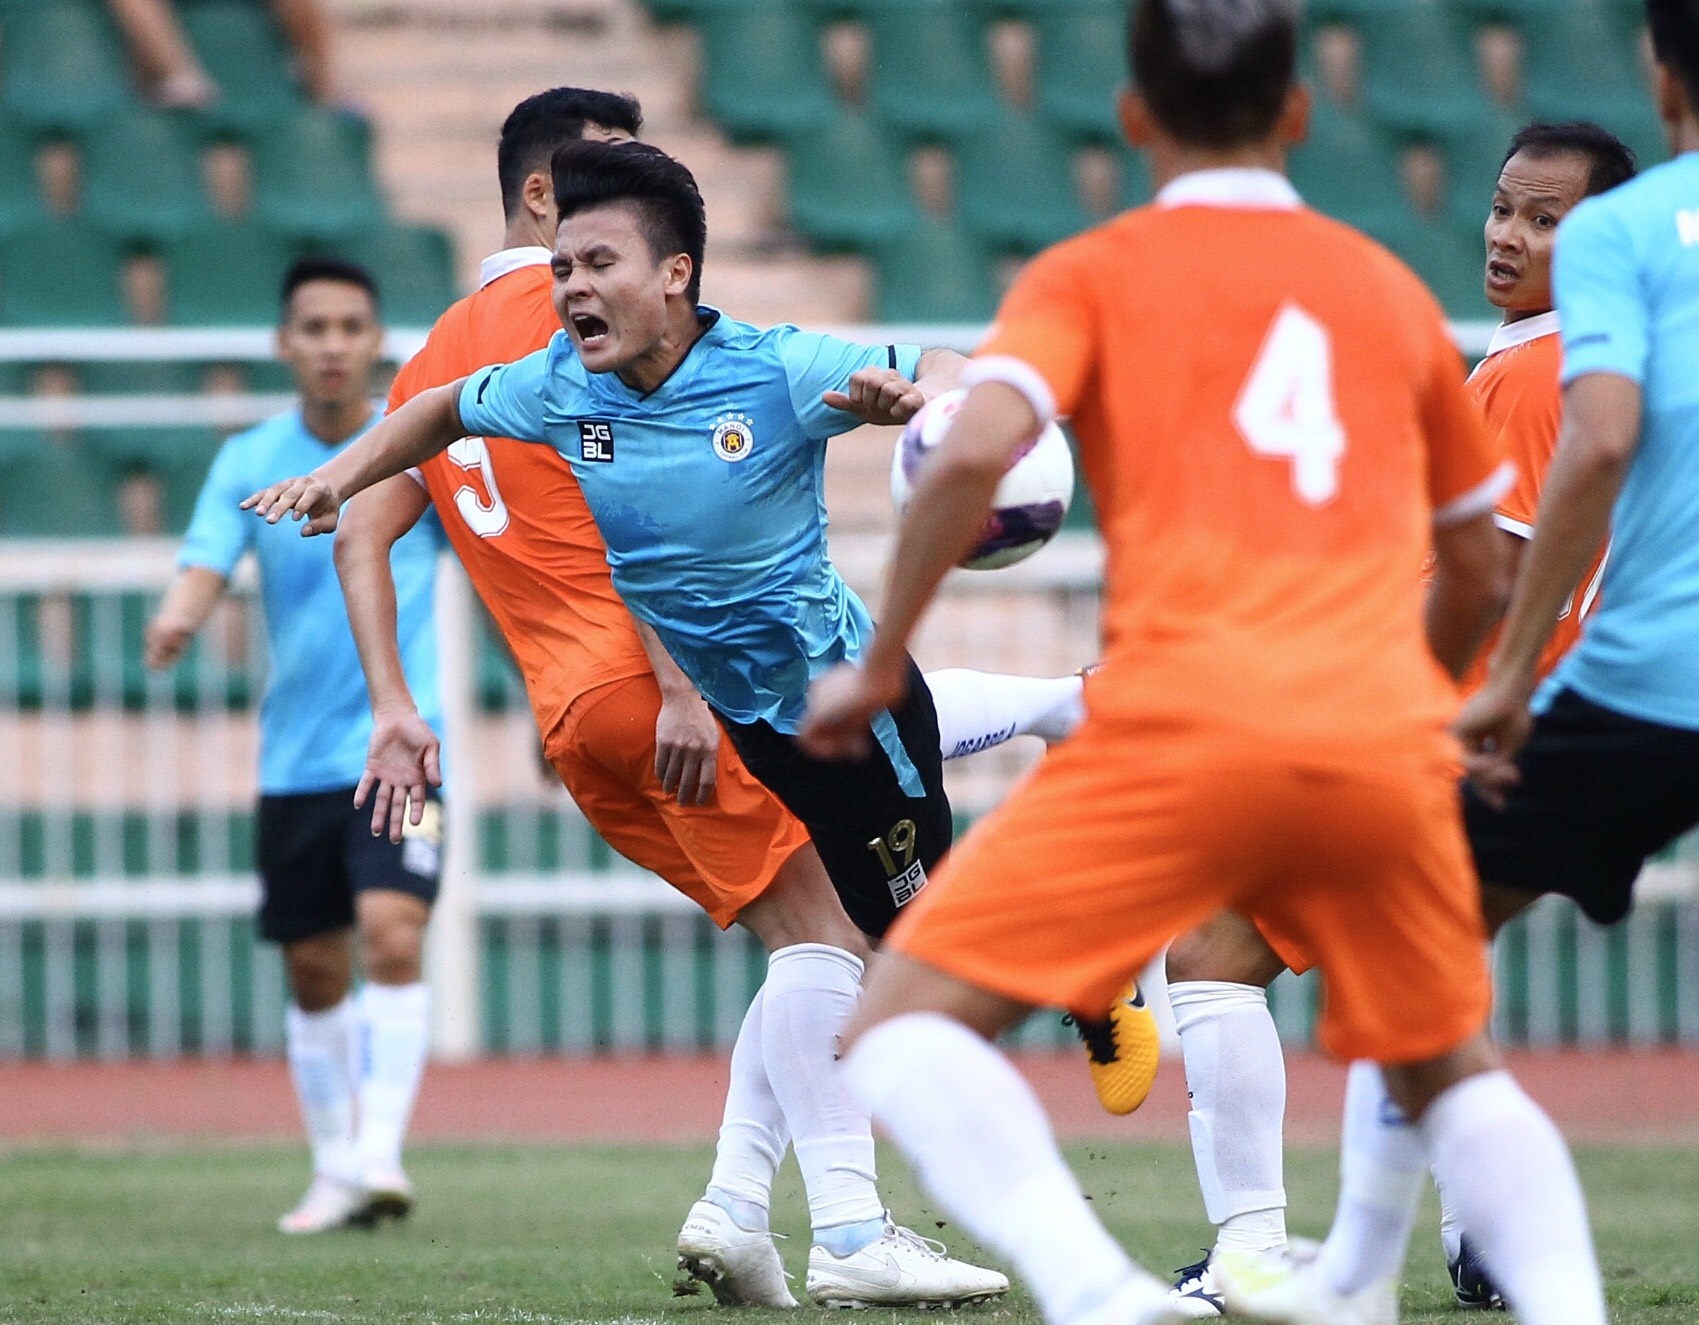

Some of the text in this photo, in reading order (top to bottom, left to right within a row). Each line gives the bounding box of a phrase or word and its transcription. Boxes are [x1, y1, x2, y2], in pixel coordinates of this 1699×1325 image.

[1231, 302, 1346, 506] 4
[583, 424, 610, 440] JG
[717, 423, 745, 435] HANOI
[583, 441, 611, 459] BL
[867, 819, 916, 877] 19
